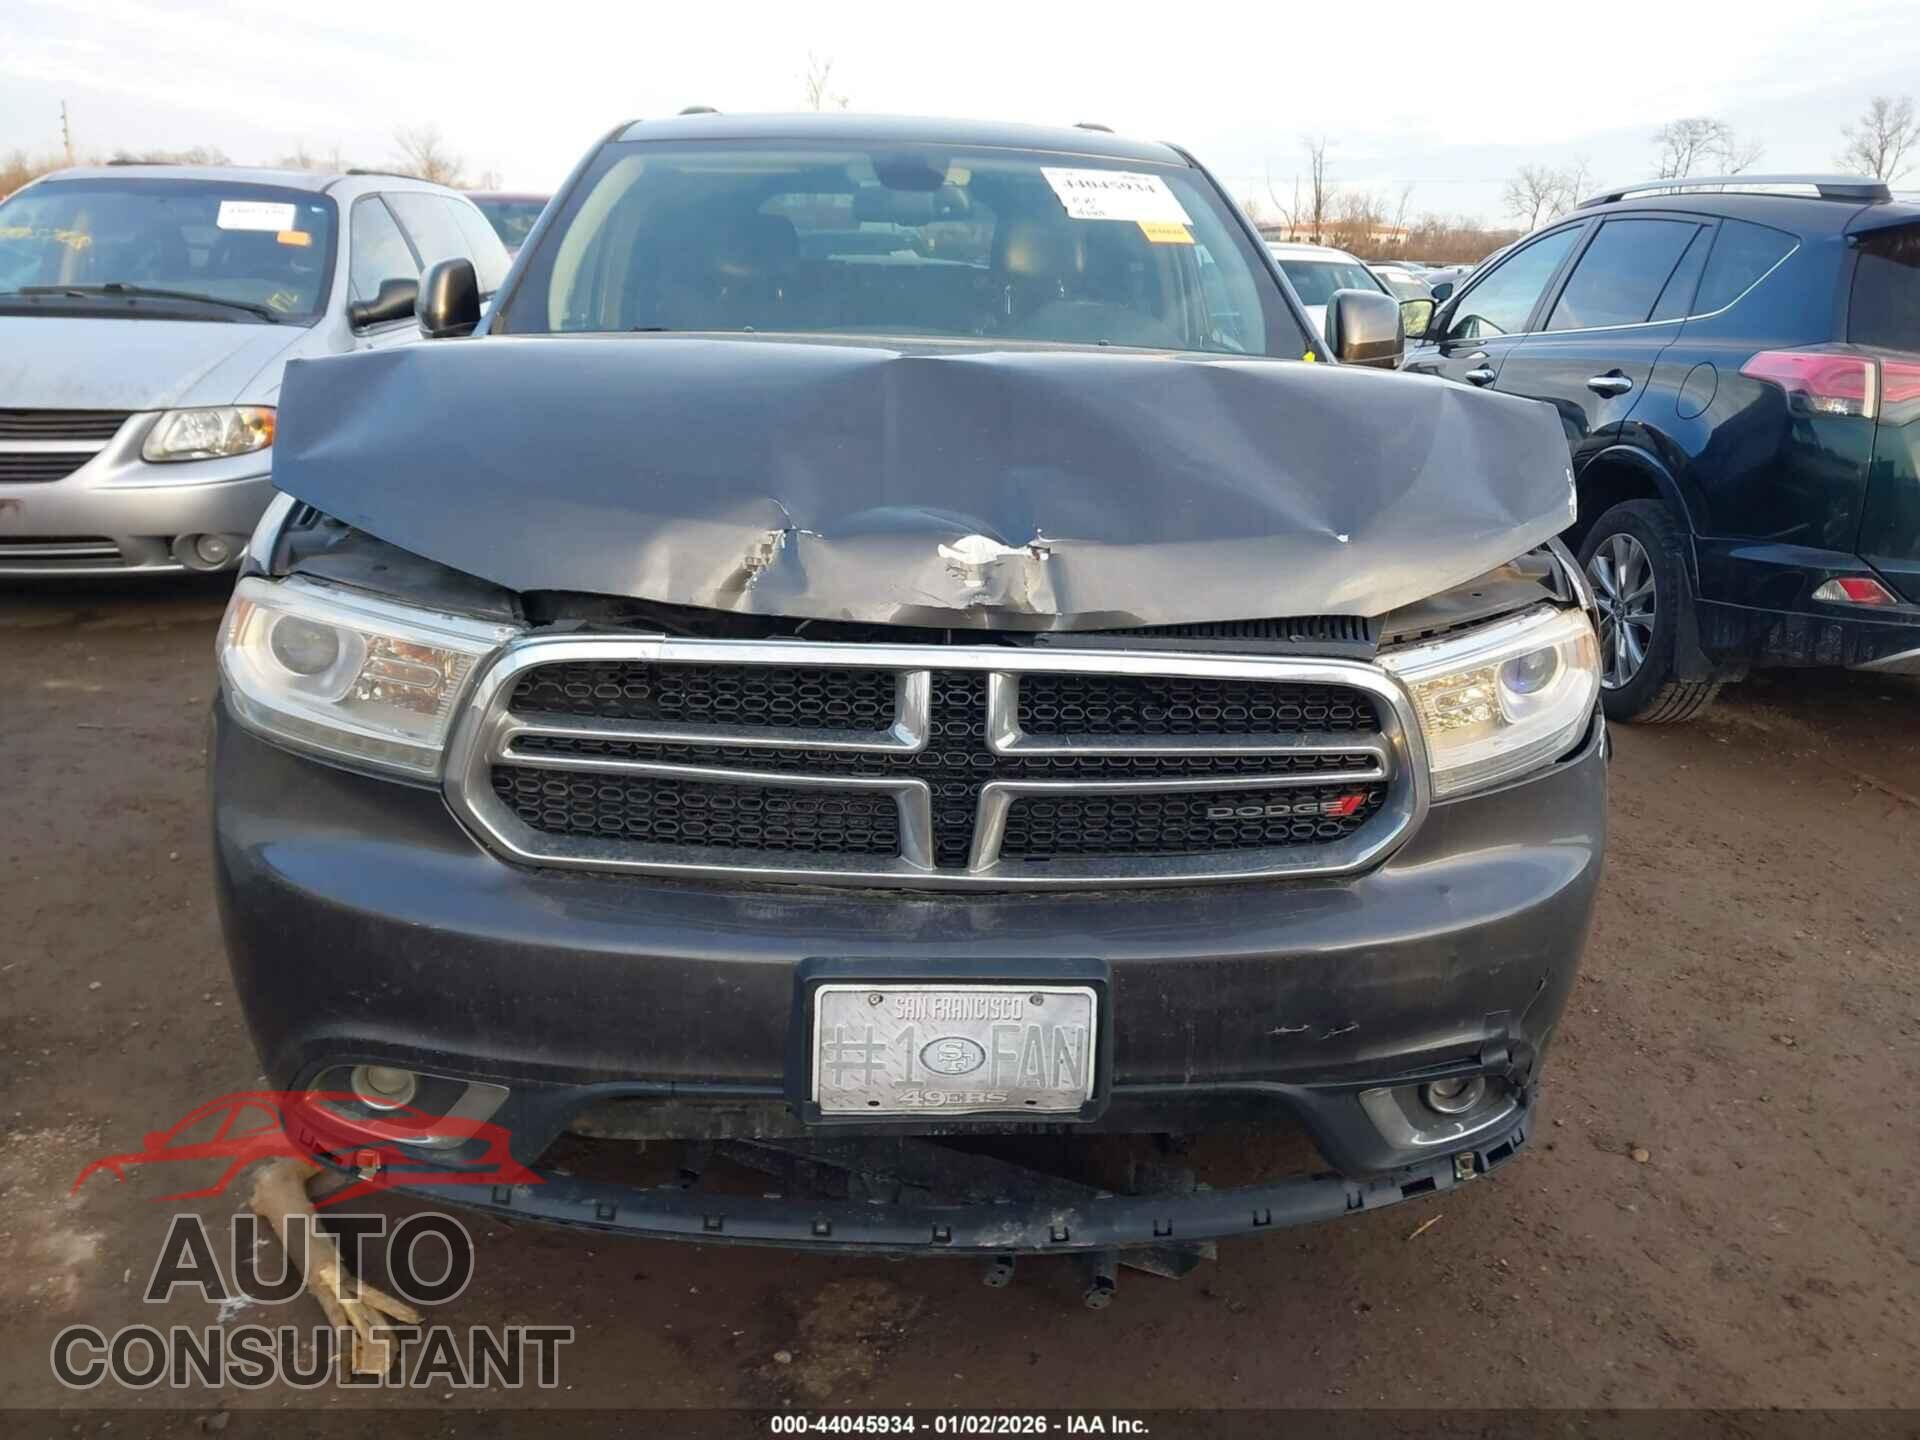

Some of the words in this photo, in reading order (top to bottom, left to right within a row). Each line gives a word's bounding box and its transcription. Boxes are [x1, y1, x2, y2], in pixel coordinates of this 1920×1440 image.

[1207, 800, 1345, 819] DODGE
[895, 997, 928, 1020] SAN
[932, 996, 1024, 1021] FRANCISCO
[823, 1023, 924, 1088] #1
[991, 1023, 1088, 1089] FAN
[897, 1088, 1009, 1107] 49ERS
